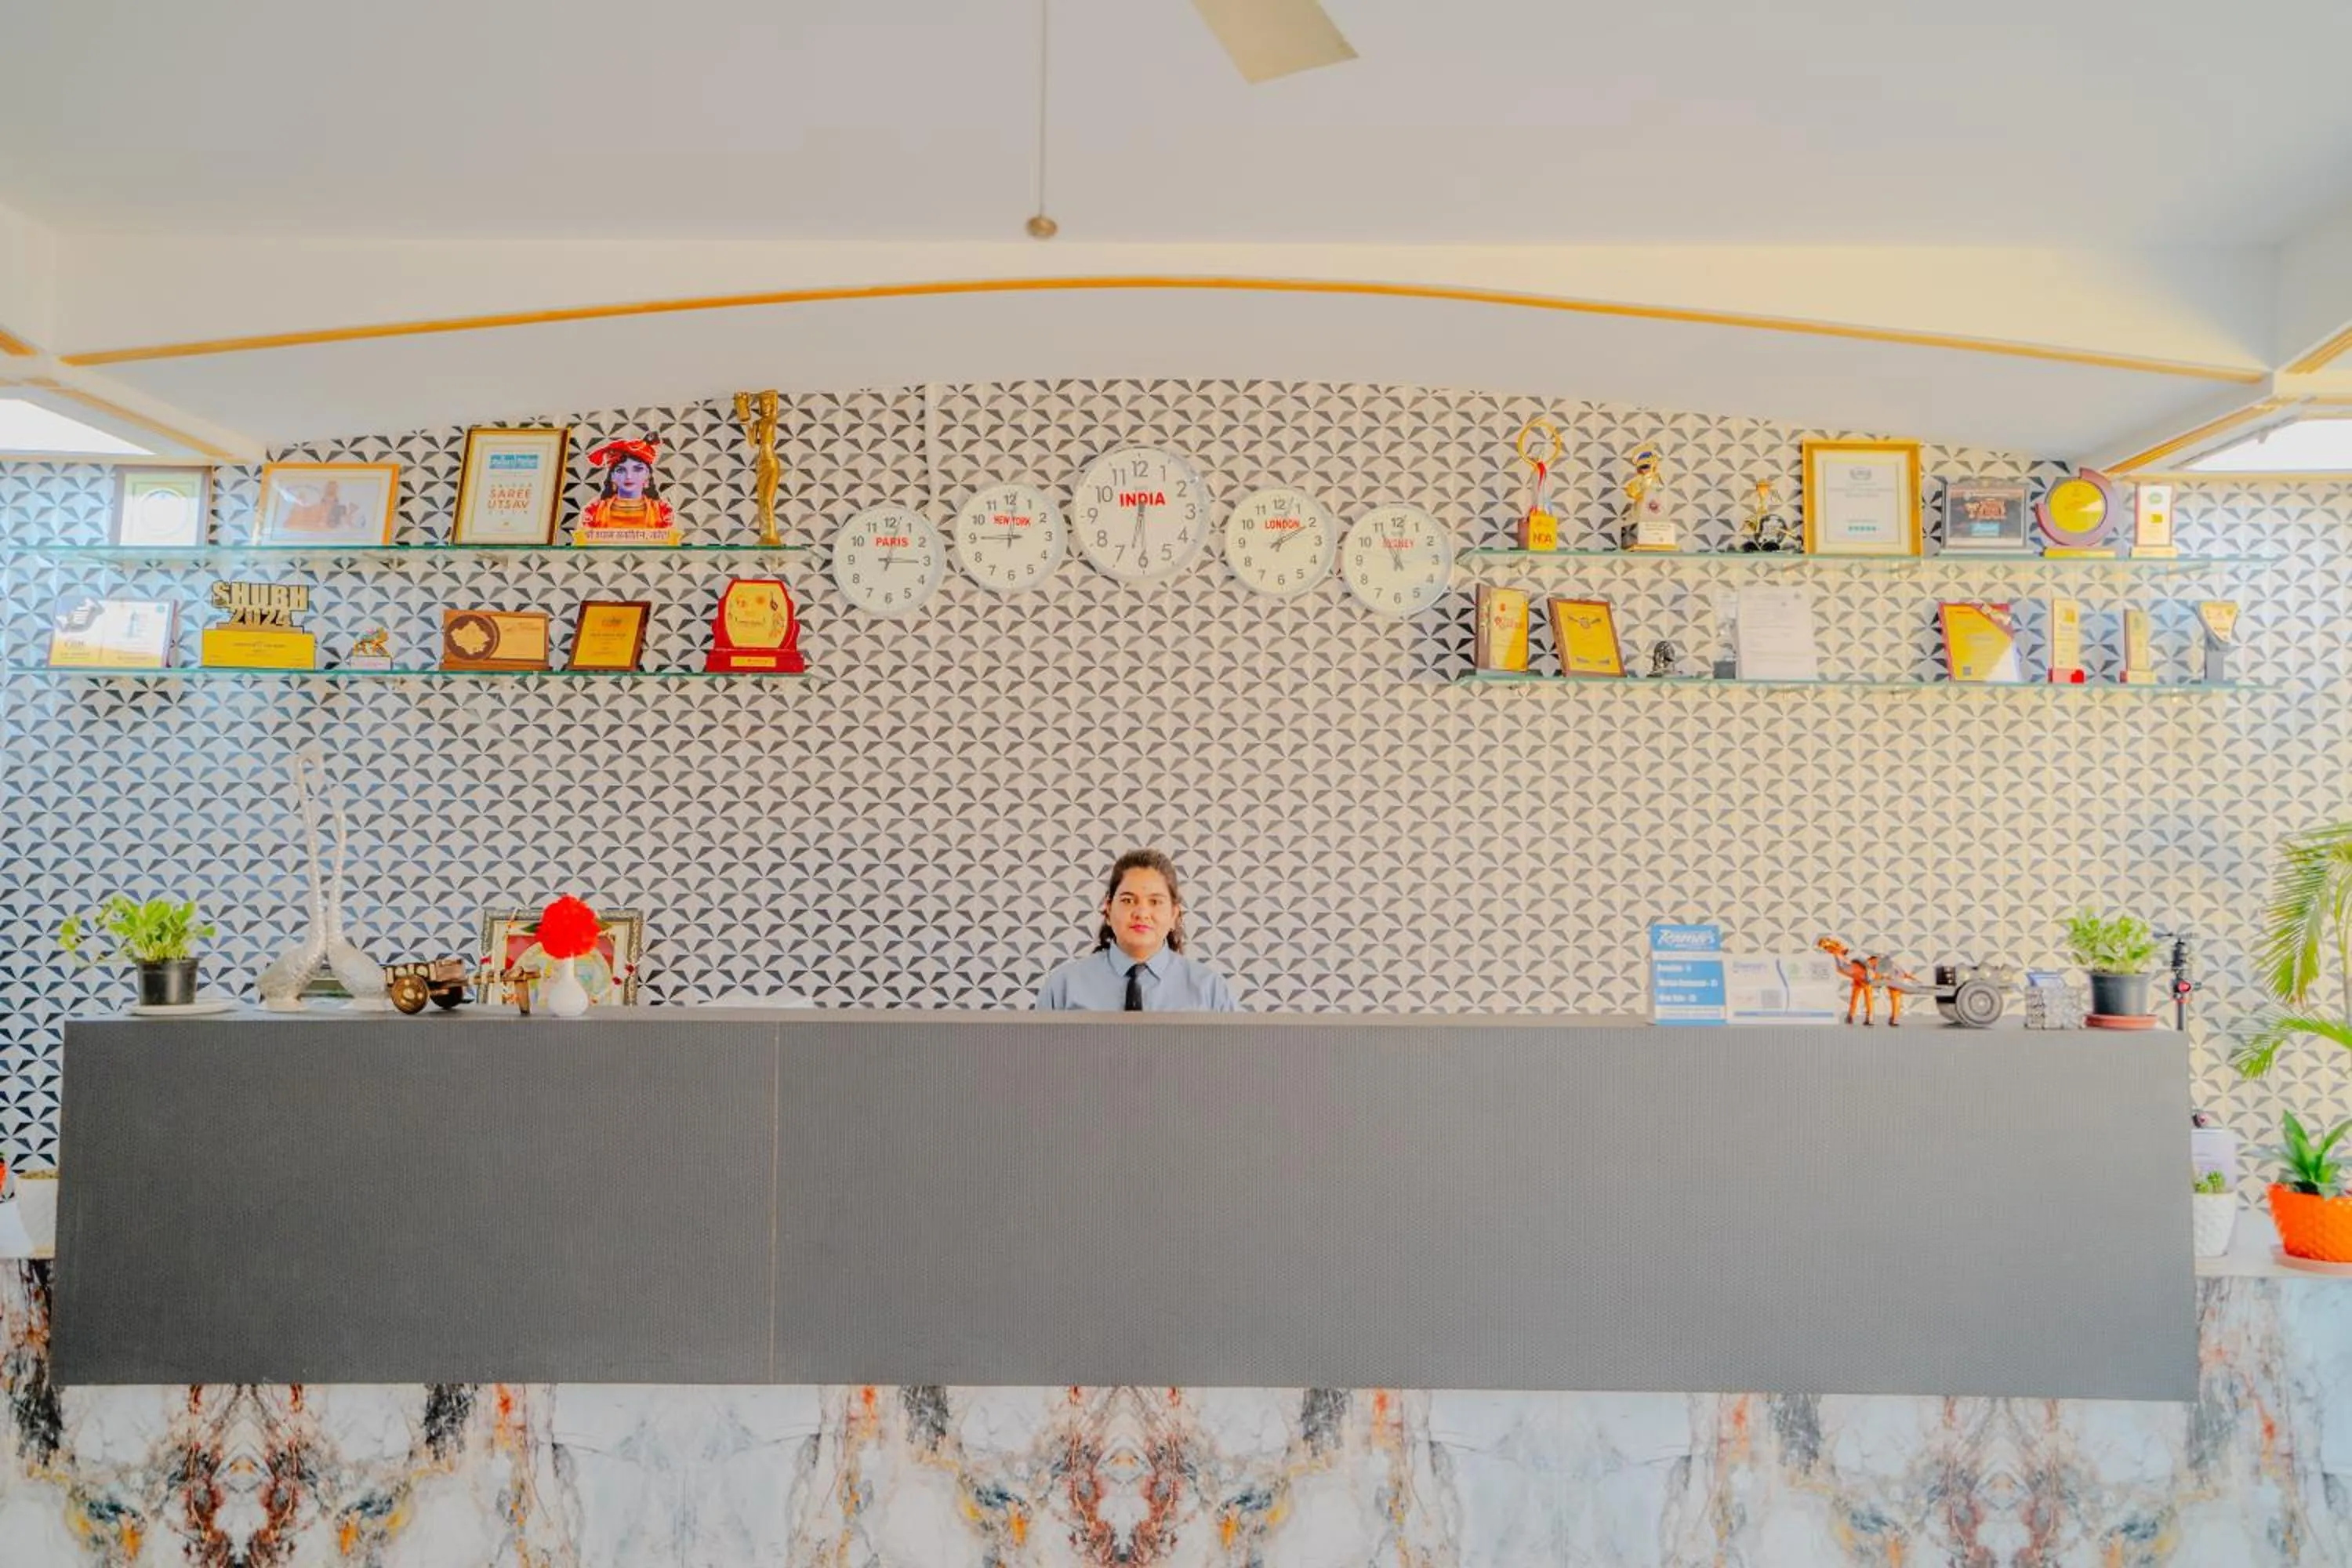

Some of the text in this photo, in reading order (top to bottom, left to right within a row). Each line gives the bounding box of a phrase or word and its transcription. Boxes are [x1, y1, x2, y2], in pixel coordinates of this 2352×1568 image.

[1132, 460, 1149, 477] 12
[1160, 465, 1166, 481] 1
[1112, 468, 1126, 486] 11
[1096, 485, 1113, 503] 10
[1176, 481, 1187, 497] 2
[987, 499, 996, 510] 11
[1004, 494, 1016, 506] 12
[1027, 499, 1032, 510] 1
[1120, 492, 1165, 507] INDIA
[1273, 499, 1285, 510] 12
[1185, 503, 1196, 520] 3
[1256, 505, 1266, 514] 11
[1297, 503, 1301, 514] 1
[972, 514, 985, 525] 10
[1040, 513, 1047, 523] 2
[1087, 508, 1098, 524] 9
[866, 522, 877, 532] 11
[884, 517, 896, 528] 12
[907, 523, 912, 533] 1
[1242, 519, 1254, 530] 10
[1265, 518, 1300, 528] LONDON
[1308, 517, 1316, 528] 2
[851, 535, 864, 546] 10
[969, 532, 977, 543] 9
[1045, 531, 1053, 541] 3
[1097, 529, 1108, 547] 8
[1178, 527, 1189, 543] 4
[1315, 535, 1322, 546] 3
[876, 537, 909, 547] PARIS
[918, 536, 925, 547] 2
[1239, 538, 1245, 548] 9
[975, 551, 982, 563] 8
[1040, 550, 1047, 561] 4
[1115, 545, 1125, 562] 7
[1161, 543, 1173, 561] 5
[848, 554, 855, 564] 9
[923, 555, 931, 566] 3
[1138, 550, 1148, 568] 6
[1244, 556, 1252, 567] 8
[1310, 554, 1316, 564] 4
[989, 564, 996, 575] 7
[1026, 564, 1034, 575] 5
[1258, 569, 1265, 580] 7
[1296, 568, 1304, 579] 5
[853, 573, 860, 583] 8
[917, 575, 924, 585] 4
[1007, 570, 1015, 581] 6
[1278, 574, 1284, 585] 6
[212, 580, 310, 612] SHUBH
[866, 587, 873, 598] 7
[885, 592, 892, 604] 6
[904, 588, 912, 599] 5
[229, 607, 294, 627] 2024
